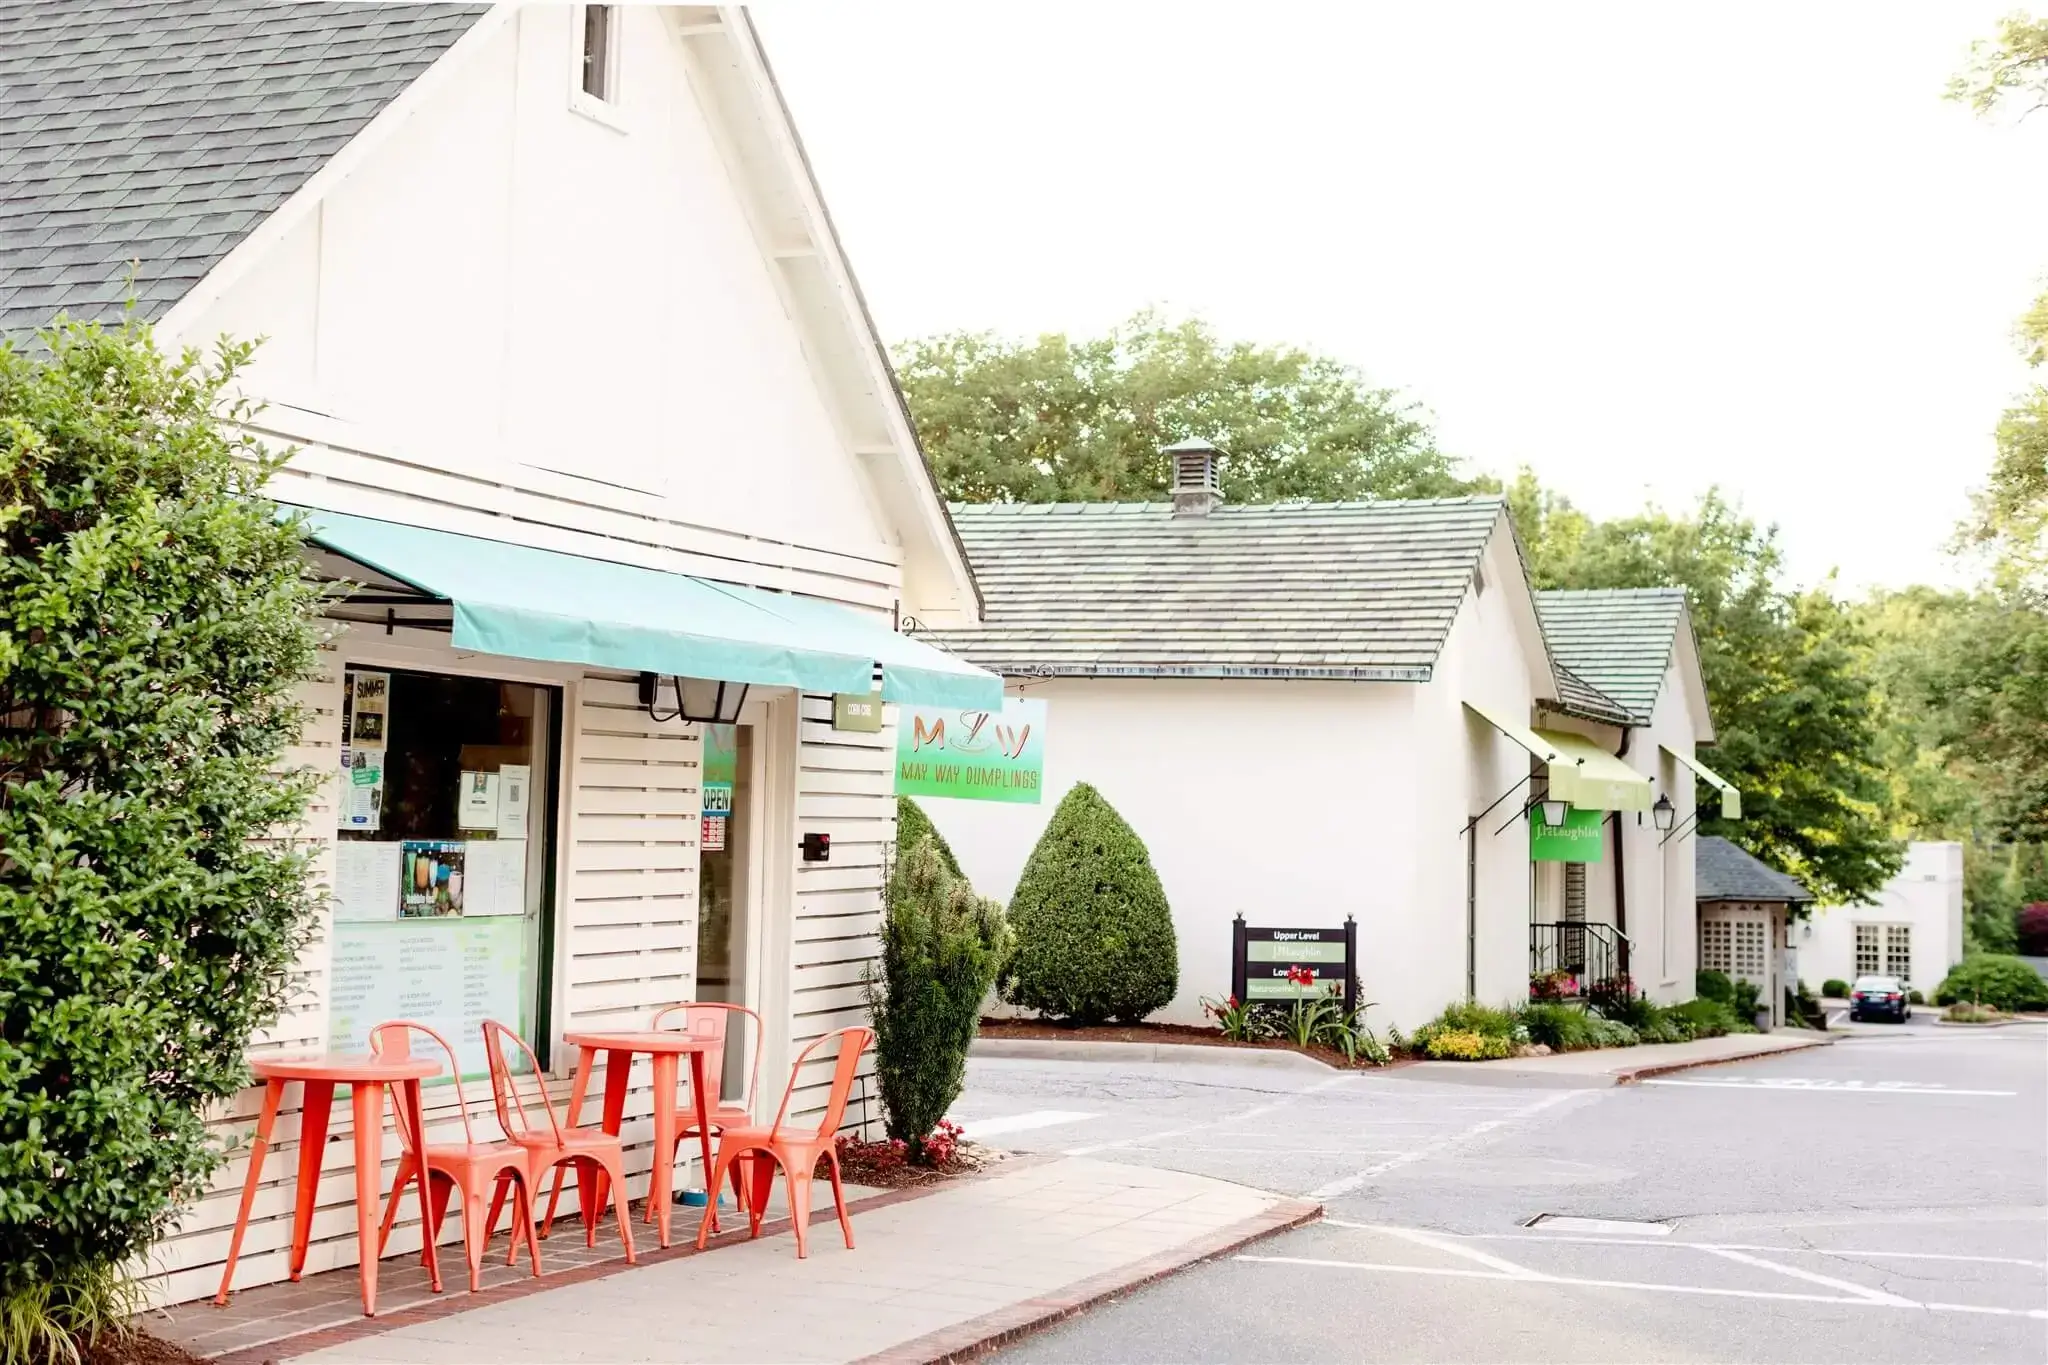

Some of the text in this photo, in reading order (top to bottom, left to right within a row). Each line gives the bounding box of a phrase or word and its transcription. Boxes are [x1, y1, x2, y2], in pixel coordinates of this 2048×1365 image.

[357, 680, 385, 698] SUMMER
[901, 761, 1038, 790] MAY WAY DUMPLINGS
[704, 788, 729, 810] OPEN
[1273, 931, 1320, 941] Upper Level
